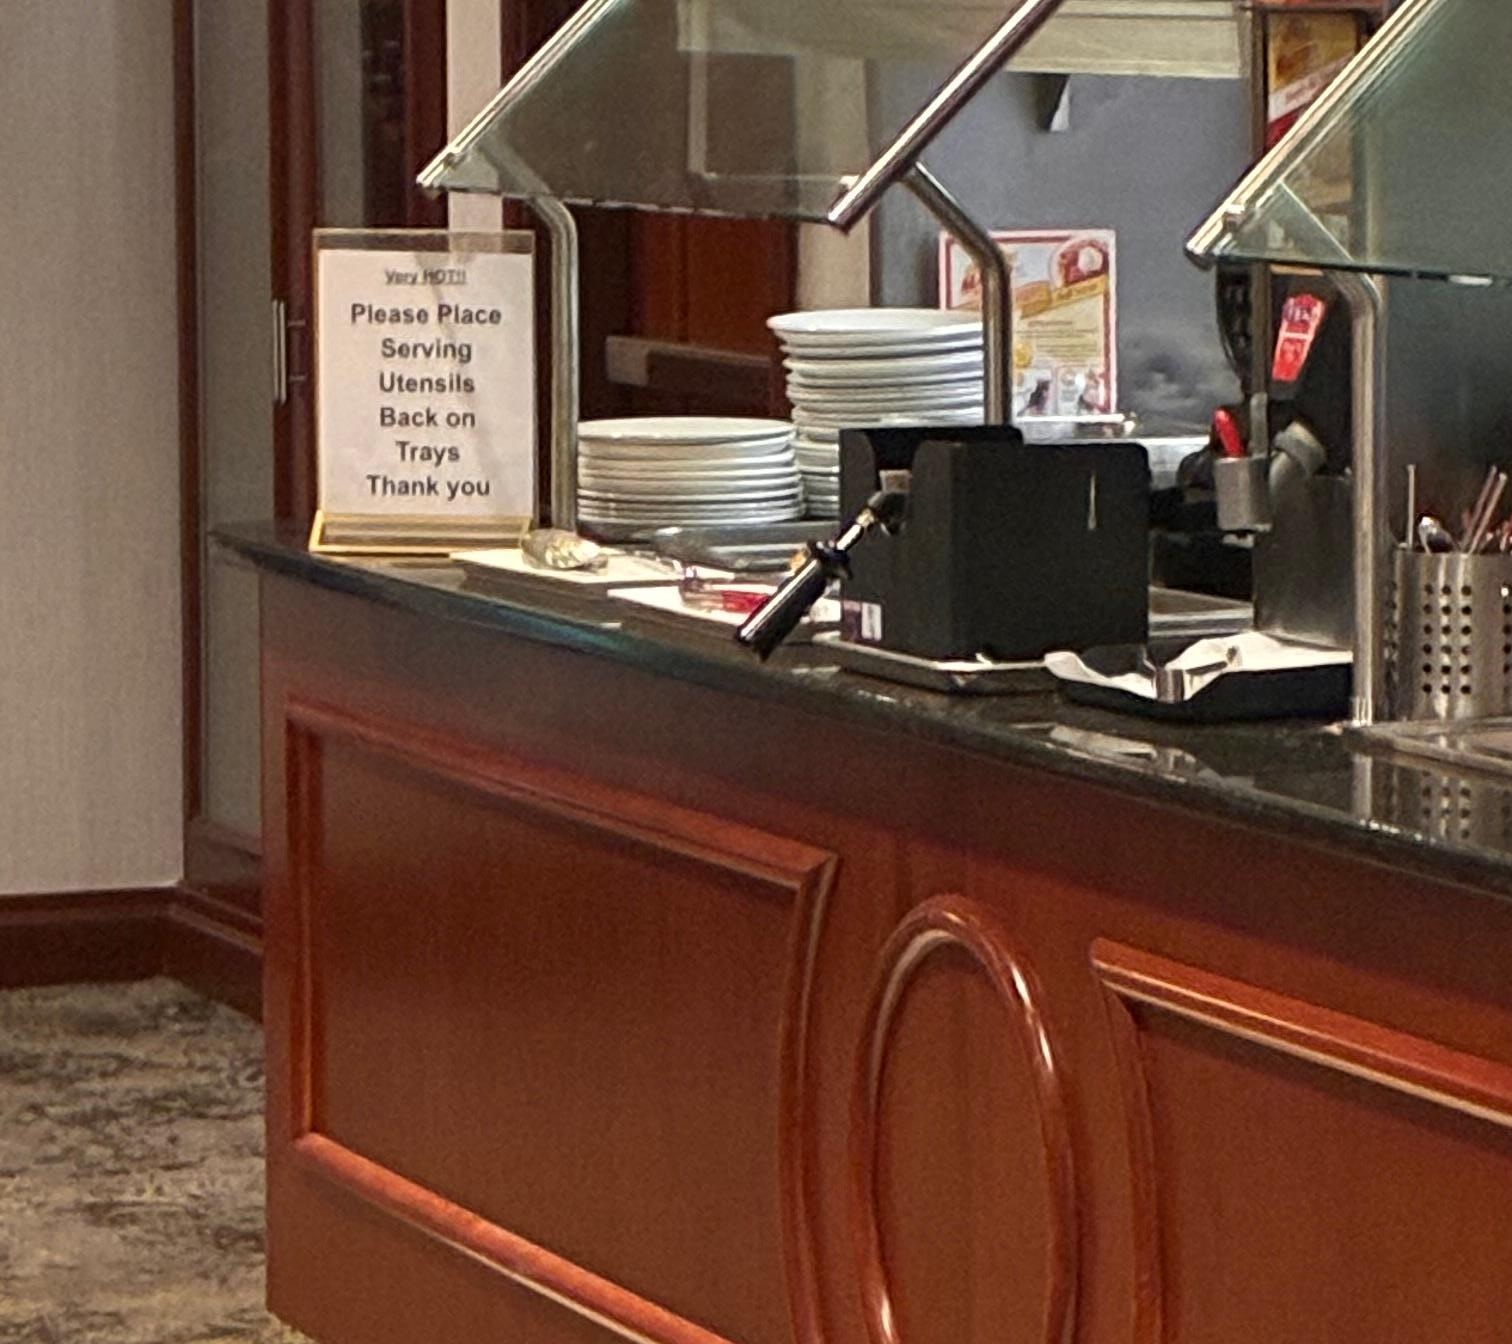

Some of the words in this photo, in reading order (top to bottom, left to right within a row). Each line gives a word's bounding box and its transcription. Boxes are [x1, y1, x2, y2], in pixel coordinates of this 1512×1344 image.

[351, 303, 429, 325] Please
[436, 304, 502, 325] Place
[381, 338, 472, 363] Serving
[378, 371, 475, 394] Utensils
[379, 407, 437, 428] Back
[446, 411, 476, 428] on
[396, 441, 460, 466] Trays
[366, 475, 439, 497] Thank
[447, 479, 490, 501] you
